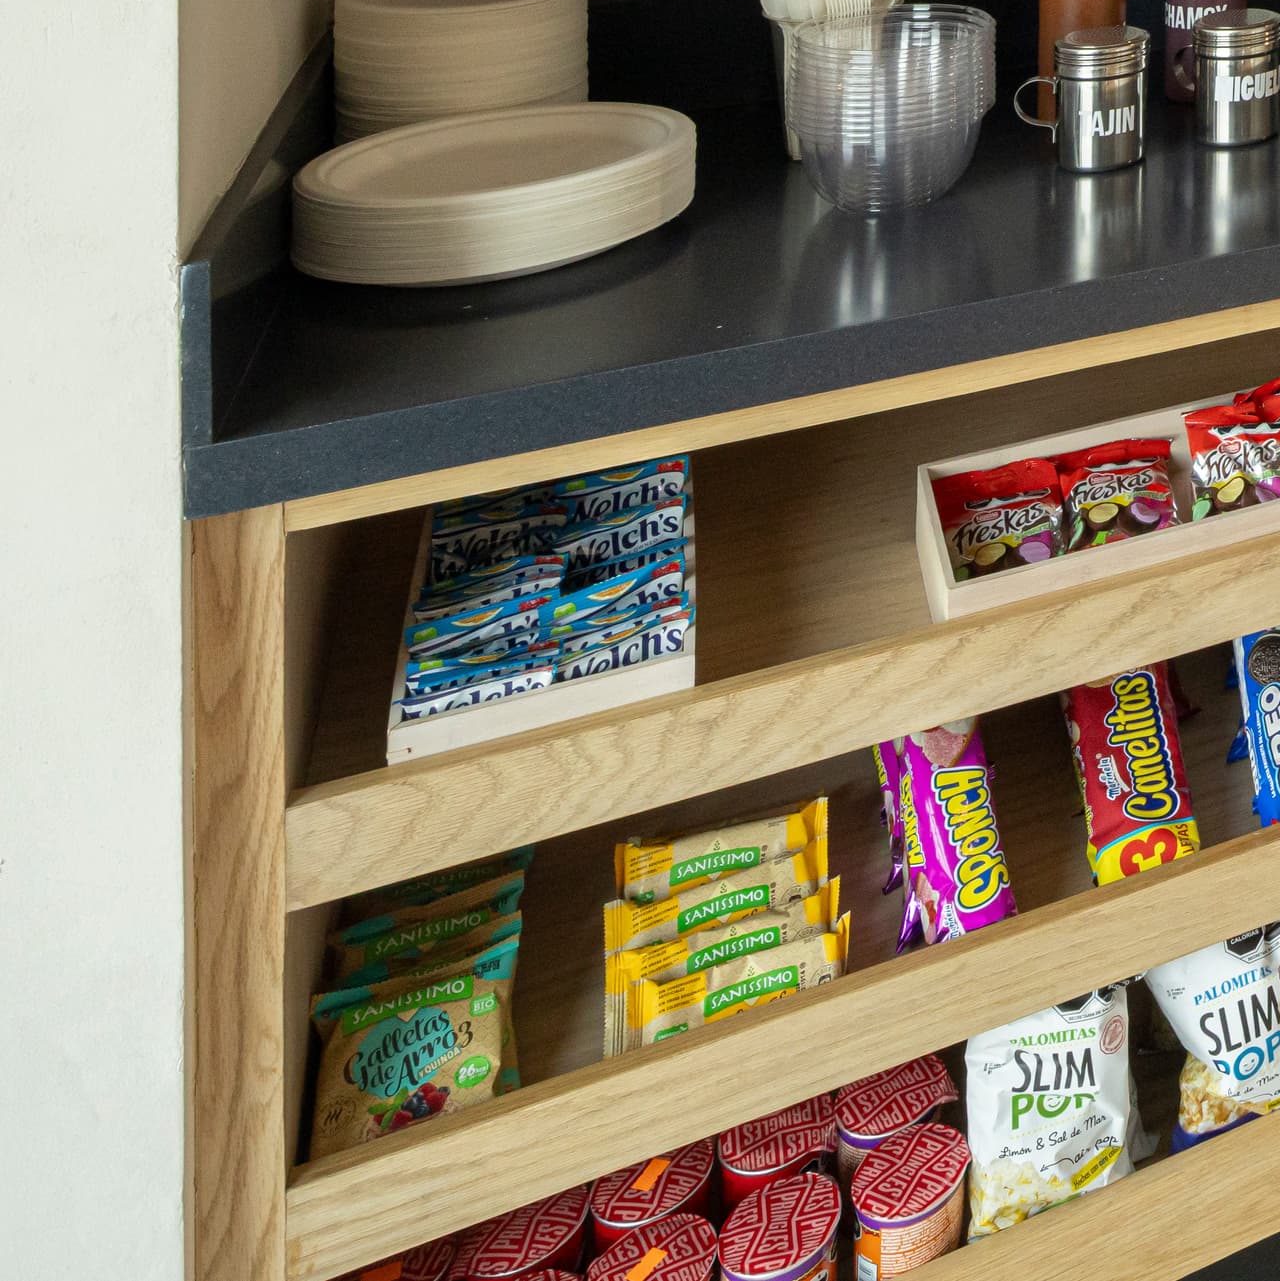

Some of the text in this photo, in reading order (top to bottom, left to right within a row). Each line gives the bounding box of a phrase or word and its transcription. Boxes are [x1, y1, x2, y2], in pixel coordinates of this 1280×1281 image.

[1072, 470, 1153, 507] Freskas
[569, 514, 679, 568] Welch's
[952, 503, 1044, 554] Freskas
[1107, 673, 1175, 819] Canelitas
[935, 768, 1010, 910] SPONCH
[1120, 828, 1179, 877] 3
[676, 851, 755, 879] SANISSIMO
[684, 890, 764, 925] SANISSIMO
[375, 912, 481, 955] SANISSIMO
[694, 931, 775, 968] SANISSIMO
[352, 980, 465, 1025] SANISSIMO
[473, 998, 495, 1013] BIO
[711, 970, 793, 1010] SANISSIMO
[1194, 966, 1272, 1006] PALOMITAS
[1200, 985, 1280, 1056] SLIM
[343, 1010, 450, 1092] Galletas
[424, 1047, 461, 1073] QUINOA
[1011, 1047, 1096, 1093] SLIM
[458, 1064, 475, 1085] 26
[856, 1059, 928, 1113] PRINGLES
[744, 1102, 813, 1143] PRINGLES
[1036, 1137, 1045, 1150] &
[1048, 1131, 1068, 1147] Sal
[1070, 1126, 1081, 1138] de
[1083, 1115, 1107, 1130] Mar
[877, 1132, 938, 1202] PRINGLES
[1074, 1134, 1119, 1164] air pop
[757, 1191, 801, 1253] PRINGLES
